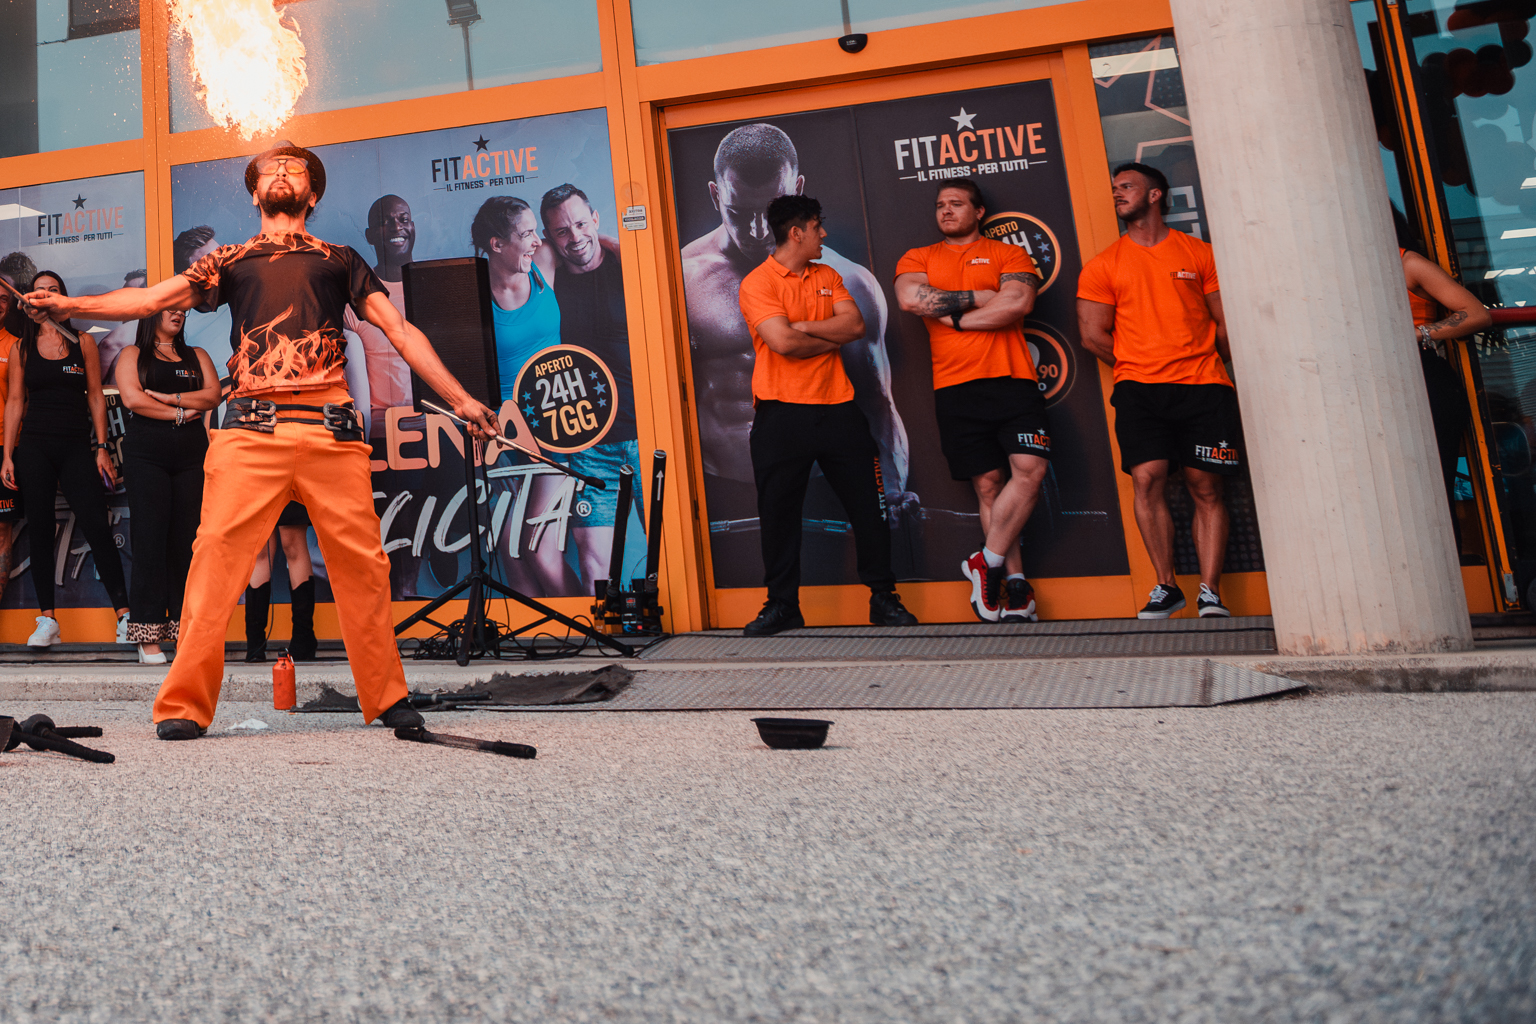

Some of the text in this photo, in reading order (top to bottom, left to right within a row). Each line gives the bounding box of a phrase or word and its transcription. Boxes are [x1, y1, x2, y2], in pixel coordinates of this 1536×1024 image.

[894, 122, 1046, 171] FITACTIVE
[431, 146, 539, 183] FITACTIVE
[917, 159, 1029, 182] IL FITNESS PER TUTTI
[446, 175, 525, 192] IL FITNESS PER TUTTI
[38, 206, 124, 238] FITACTIVE
[984, 221, 1019, 239] APERTO
[55, 236, 79, 244] FITNESS
[83, 233, 96, 242] PER
[96, 232, 113, 240] TUTTI
[534, 355, 574, 377] APERTO
[535, 368, 587, 410] 24H
[542, 400, 599, 441] 7GG
